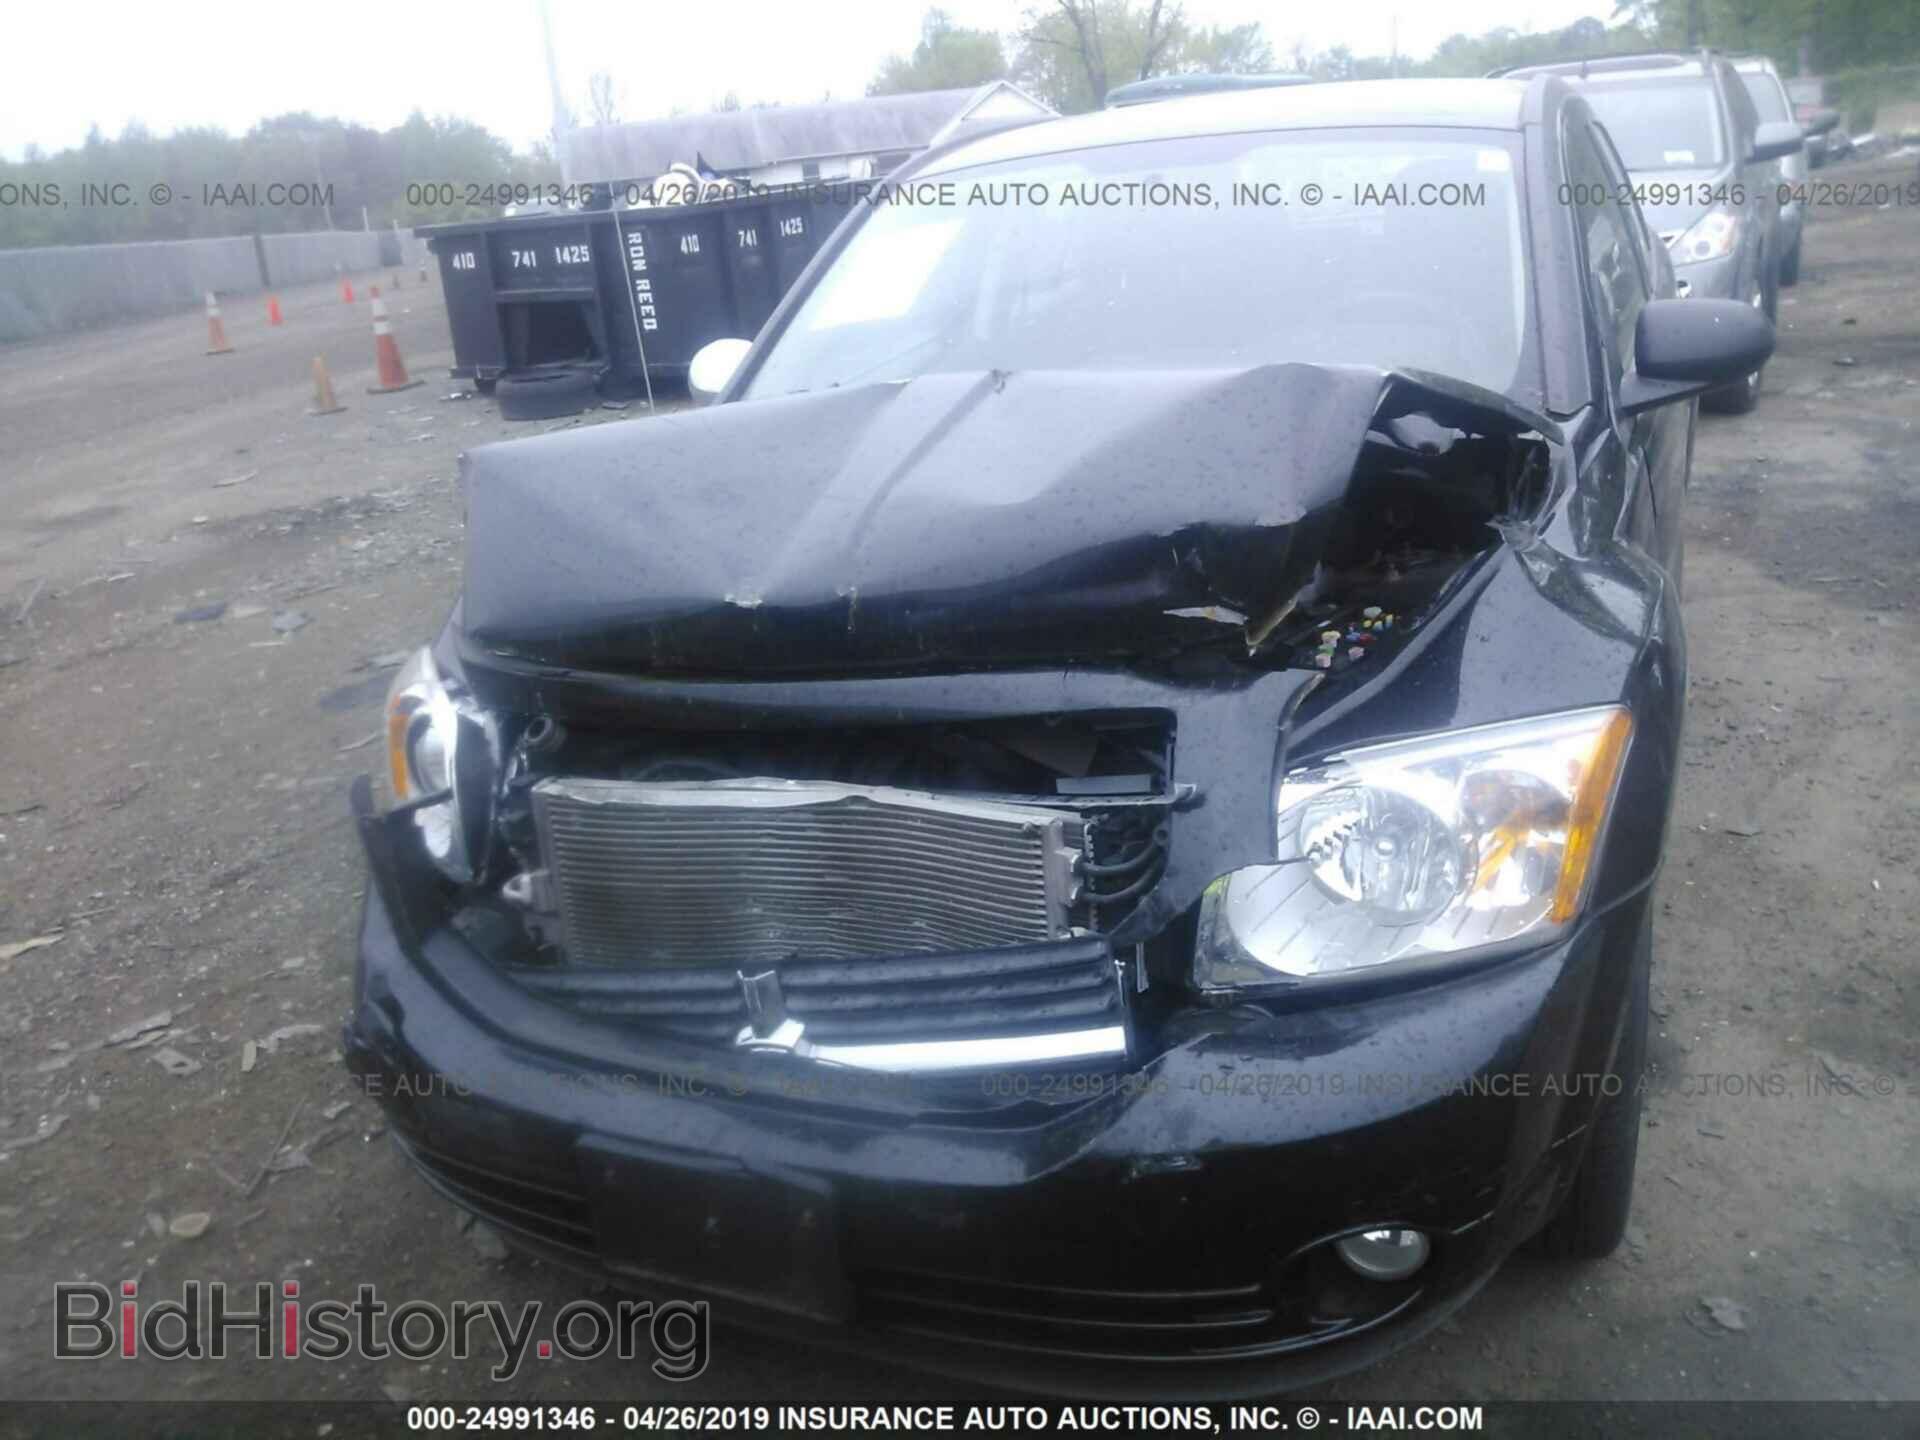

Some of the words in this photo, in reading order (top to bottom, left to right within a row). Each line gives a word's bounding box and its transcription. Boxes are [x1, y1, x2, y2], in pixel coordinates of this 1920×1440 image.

[627, 232, 647, 272] RON
[680, 234, 700, 254] 410
[737, 229, 758, 248] 741
[780, 217, 803, 237] 1425
[452, 251, 476, 270] 410
[511, 250, 537, 268] 741
[555, 245, 590, 265] 1425
[635, 279, 658, 331] REED
